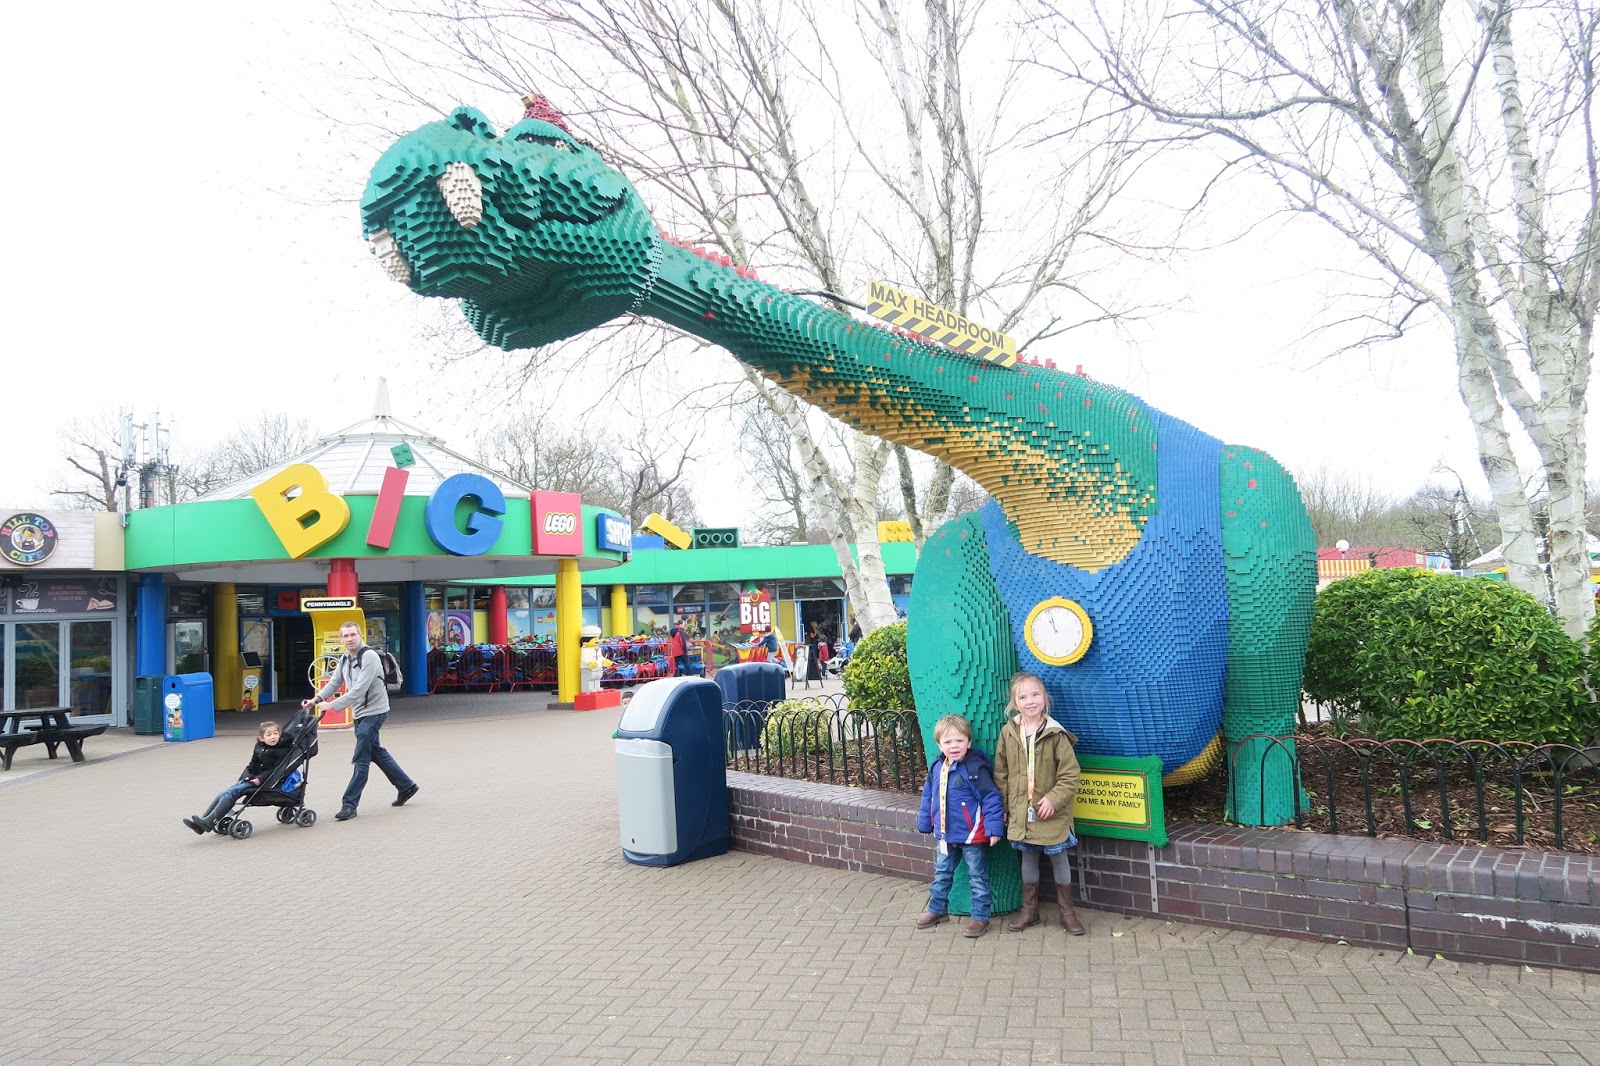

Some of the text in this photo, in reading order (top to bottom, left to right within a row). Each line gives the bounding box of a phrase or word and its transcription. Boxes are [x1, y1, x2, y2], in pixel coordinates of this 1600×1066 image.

[870, 281, 1004, 349] MAX HEADROOM
[1, 515, 54, 537] HILL TOP
[543, 511, 577, 535] LEGO
[606, 518, 631, 547] SHOP
[10, 550, 45, 562] CAFE
[306, 600, 352, 608] PENNYMANGLE
[751, 623, 771, 632] SHO
[1091, 780, 1110, 788] YOUR
[1123, 792, 1145, 800] CLIMB
[1106, 799, 1117, 807] MY
